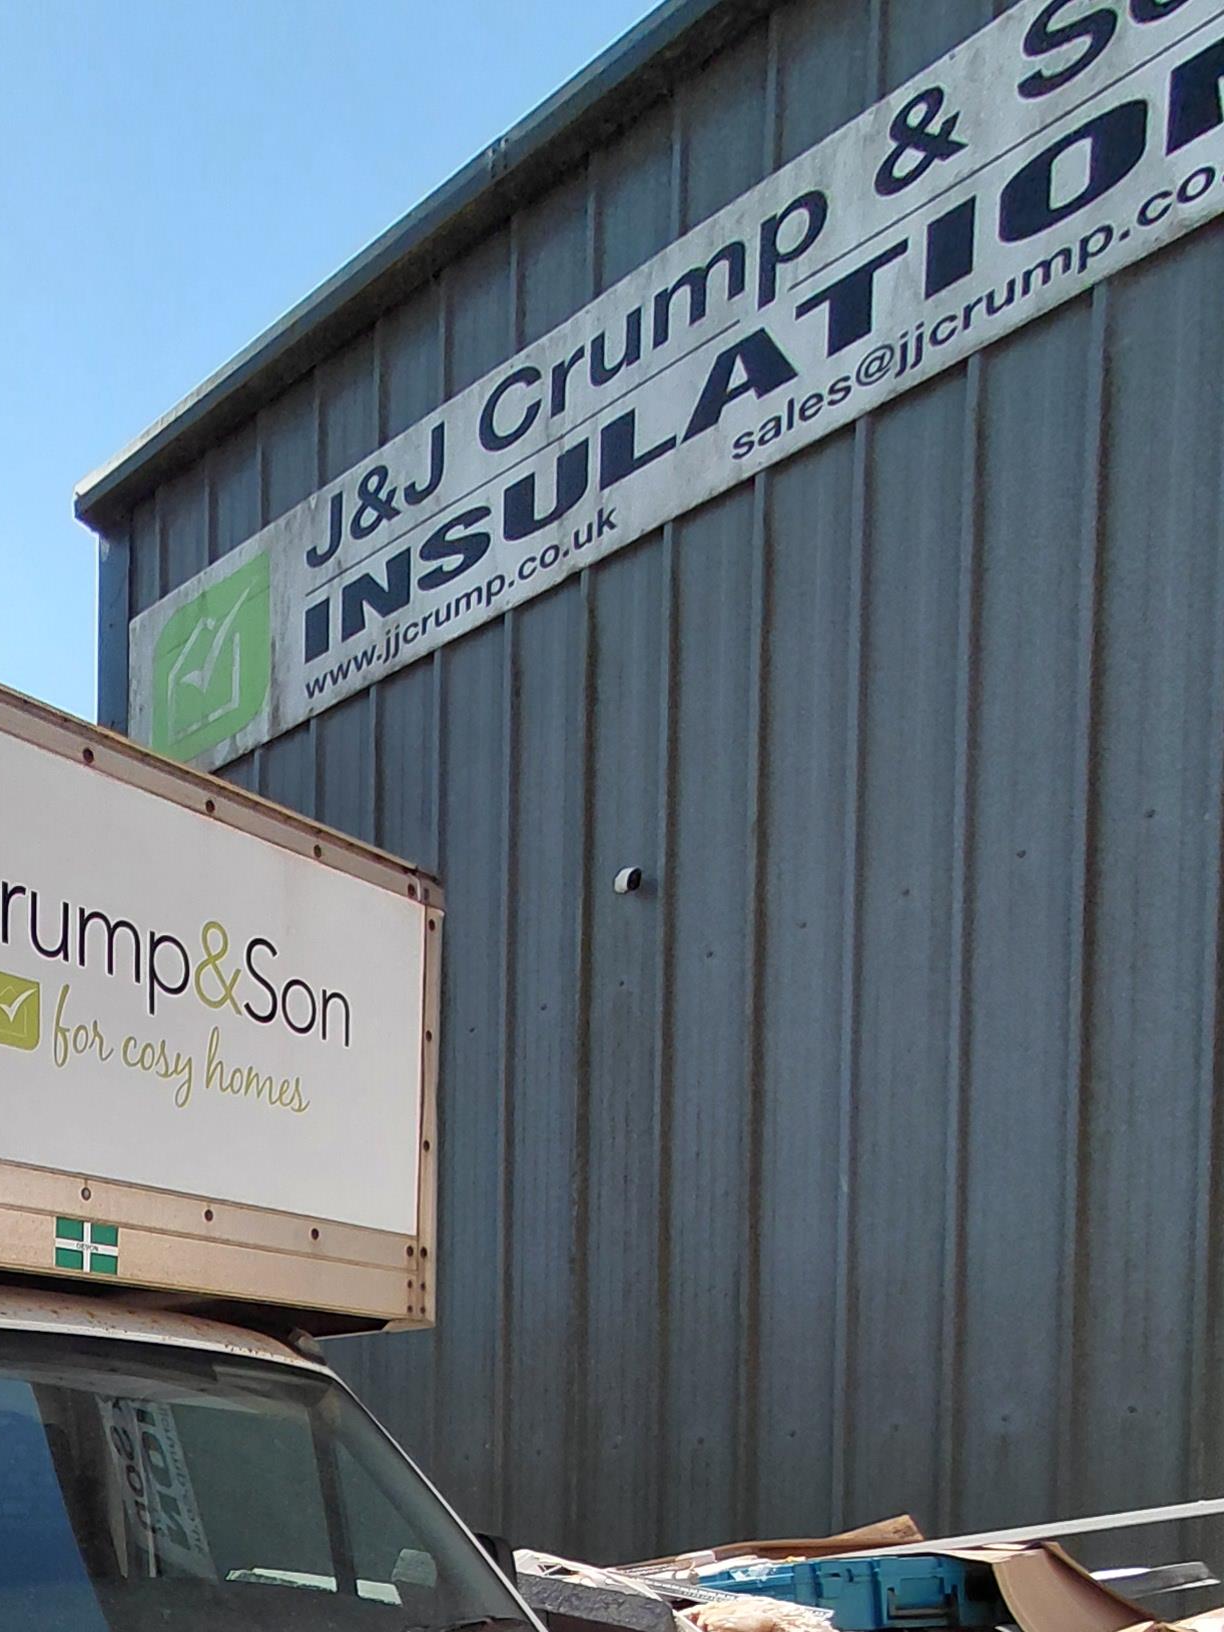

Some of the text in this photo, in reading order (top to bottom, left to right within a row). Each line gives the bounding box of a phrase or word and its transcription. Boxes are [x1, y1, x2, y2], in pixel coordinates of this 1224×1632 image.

[306, 421, 446, 568] J&J
[478, 189, 828, 452] Crump
[874, 85, 969, 196] &
[731, 164, 1224, 461] sales@jjcrump.co
[305, 504, 618, 699] www.jjcrump.co.uk
[53, 983, 311, 1114] for cosy homes
